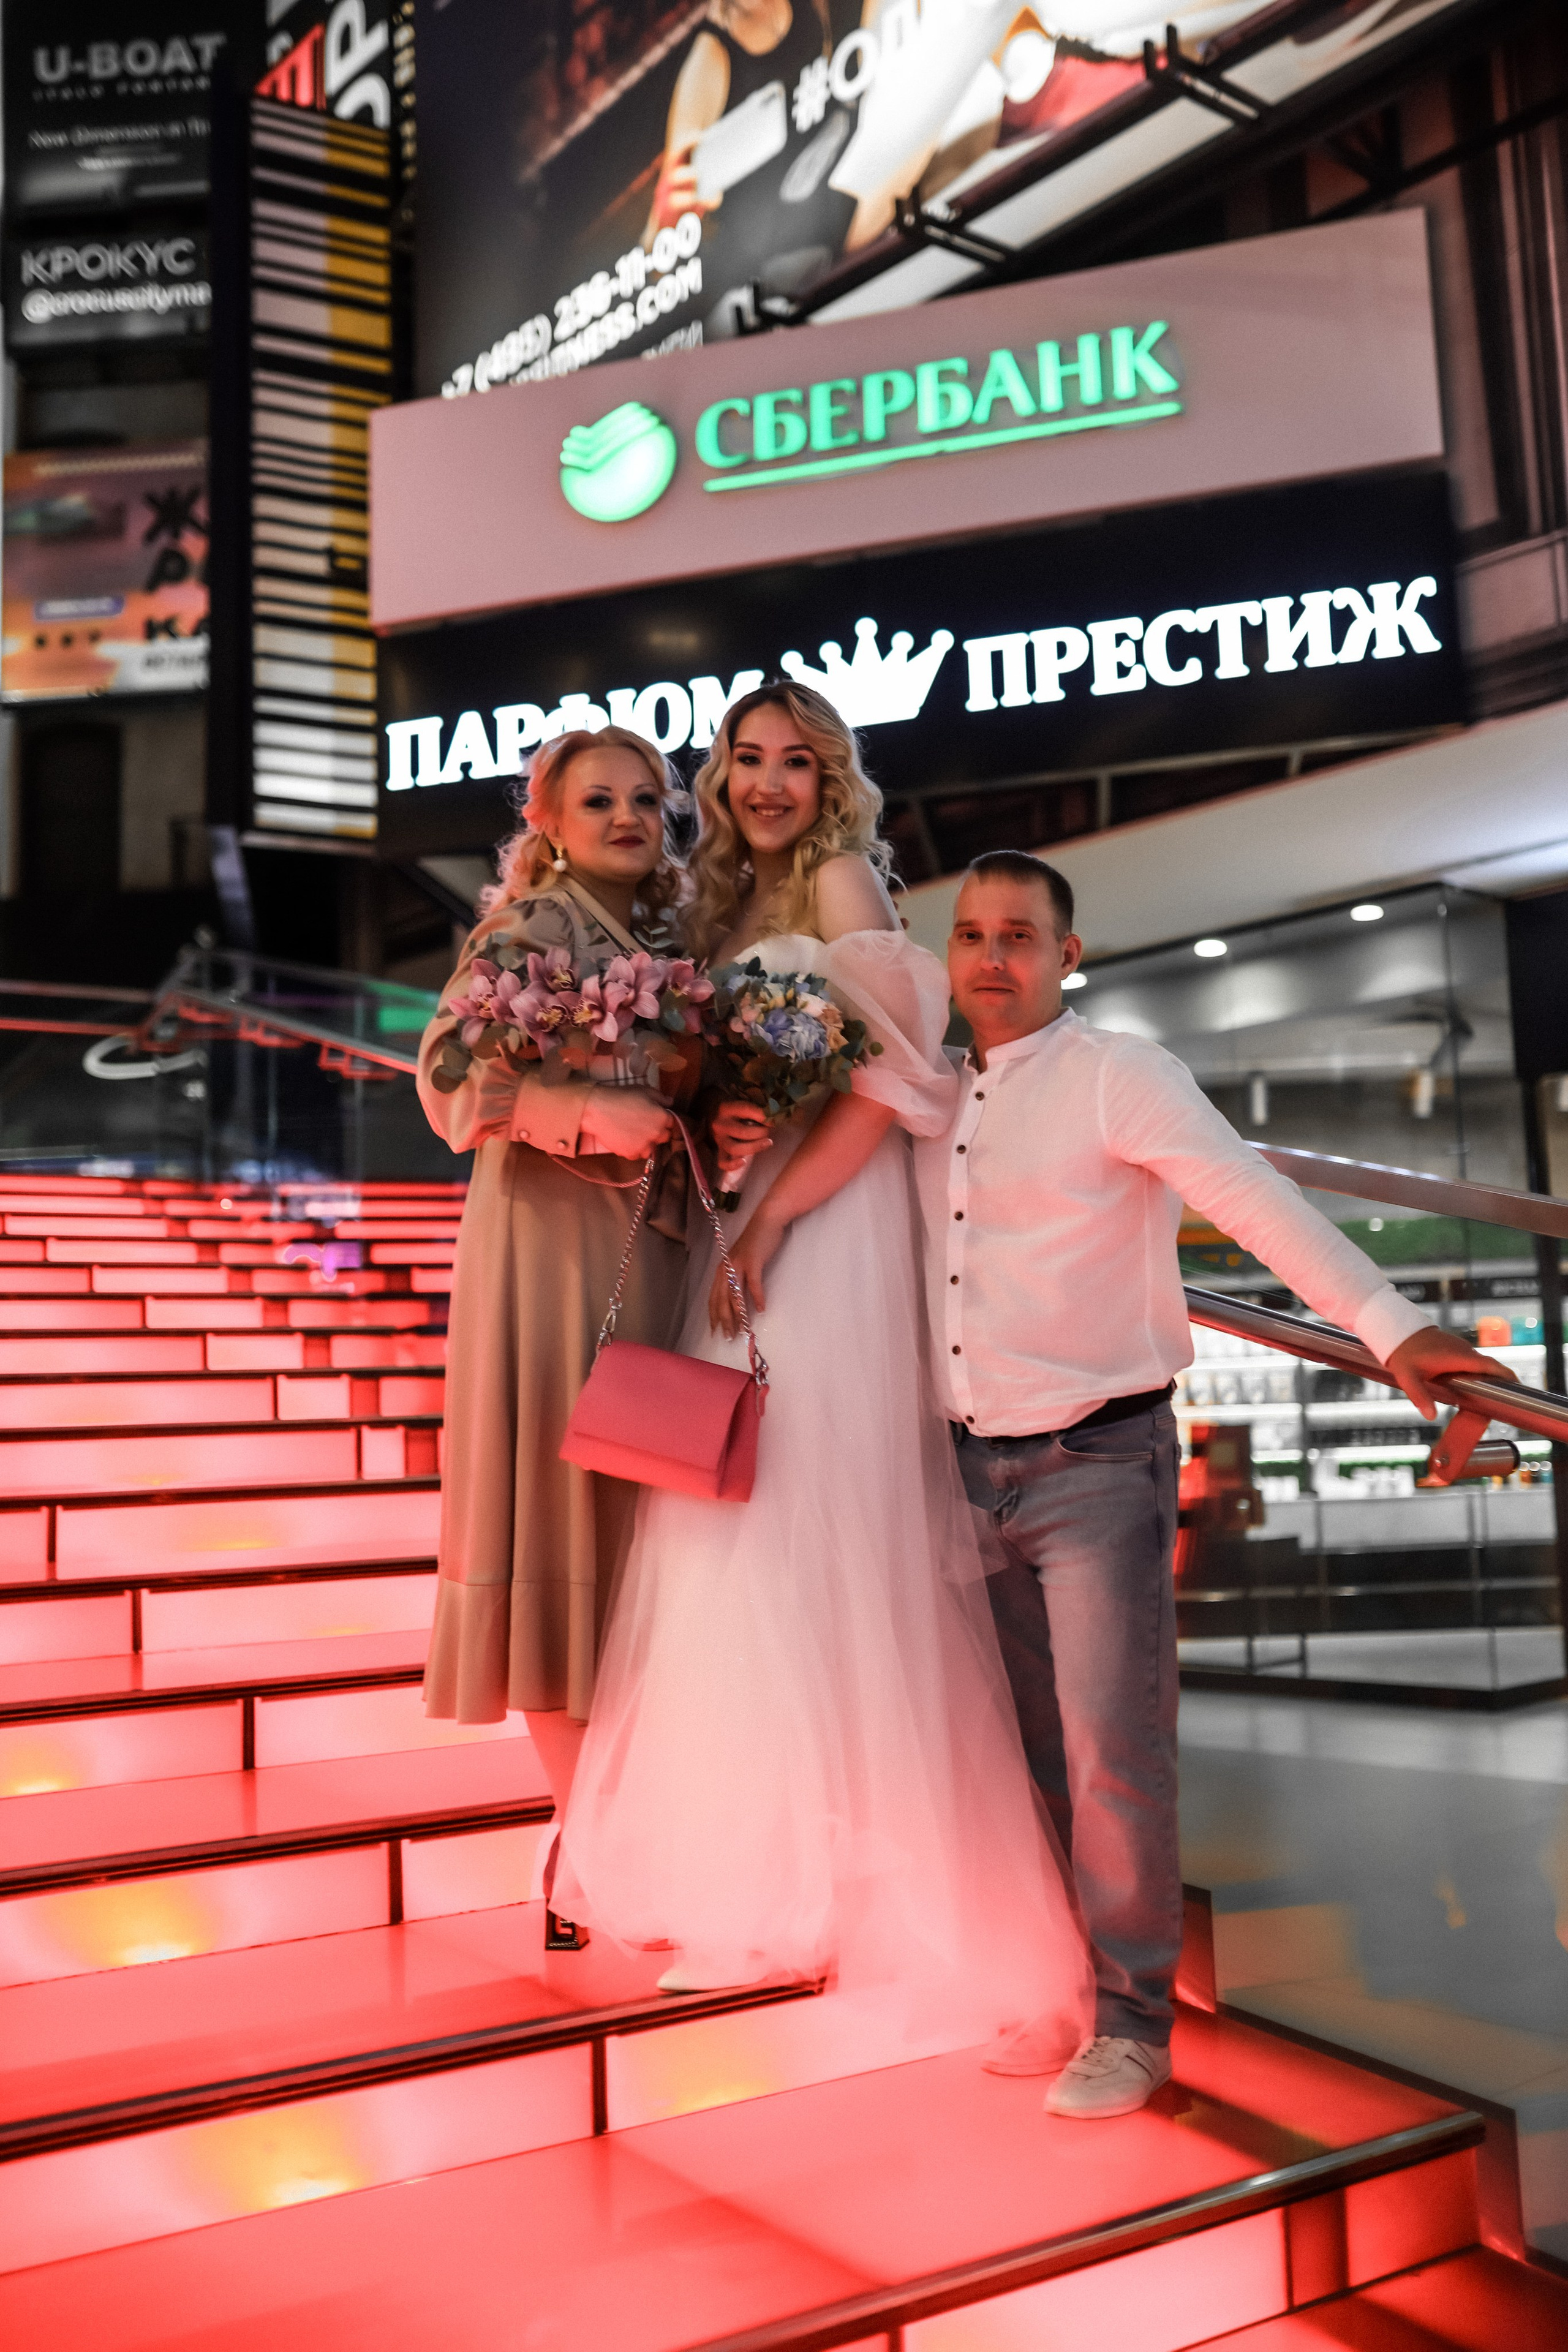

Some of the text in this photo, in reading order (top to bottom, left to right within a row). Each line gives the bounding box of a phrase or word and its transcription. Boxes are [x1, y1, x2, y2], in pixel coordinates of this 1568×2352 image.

[34, 33, 226, 84] U-BOAT
[21, 237, 195, 285] КРОКУС
[695, 320, 1180, 469] СБЕРБАНК
[386, 576, 1442, 790] ПАРФЮМ ПРЕСТИЖ
